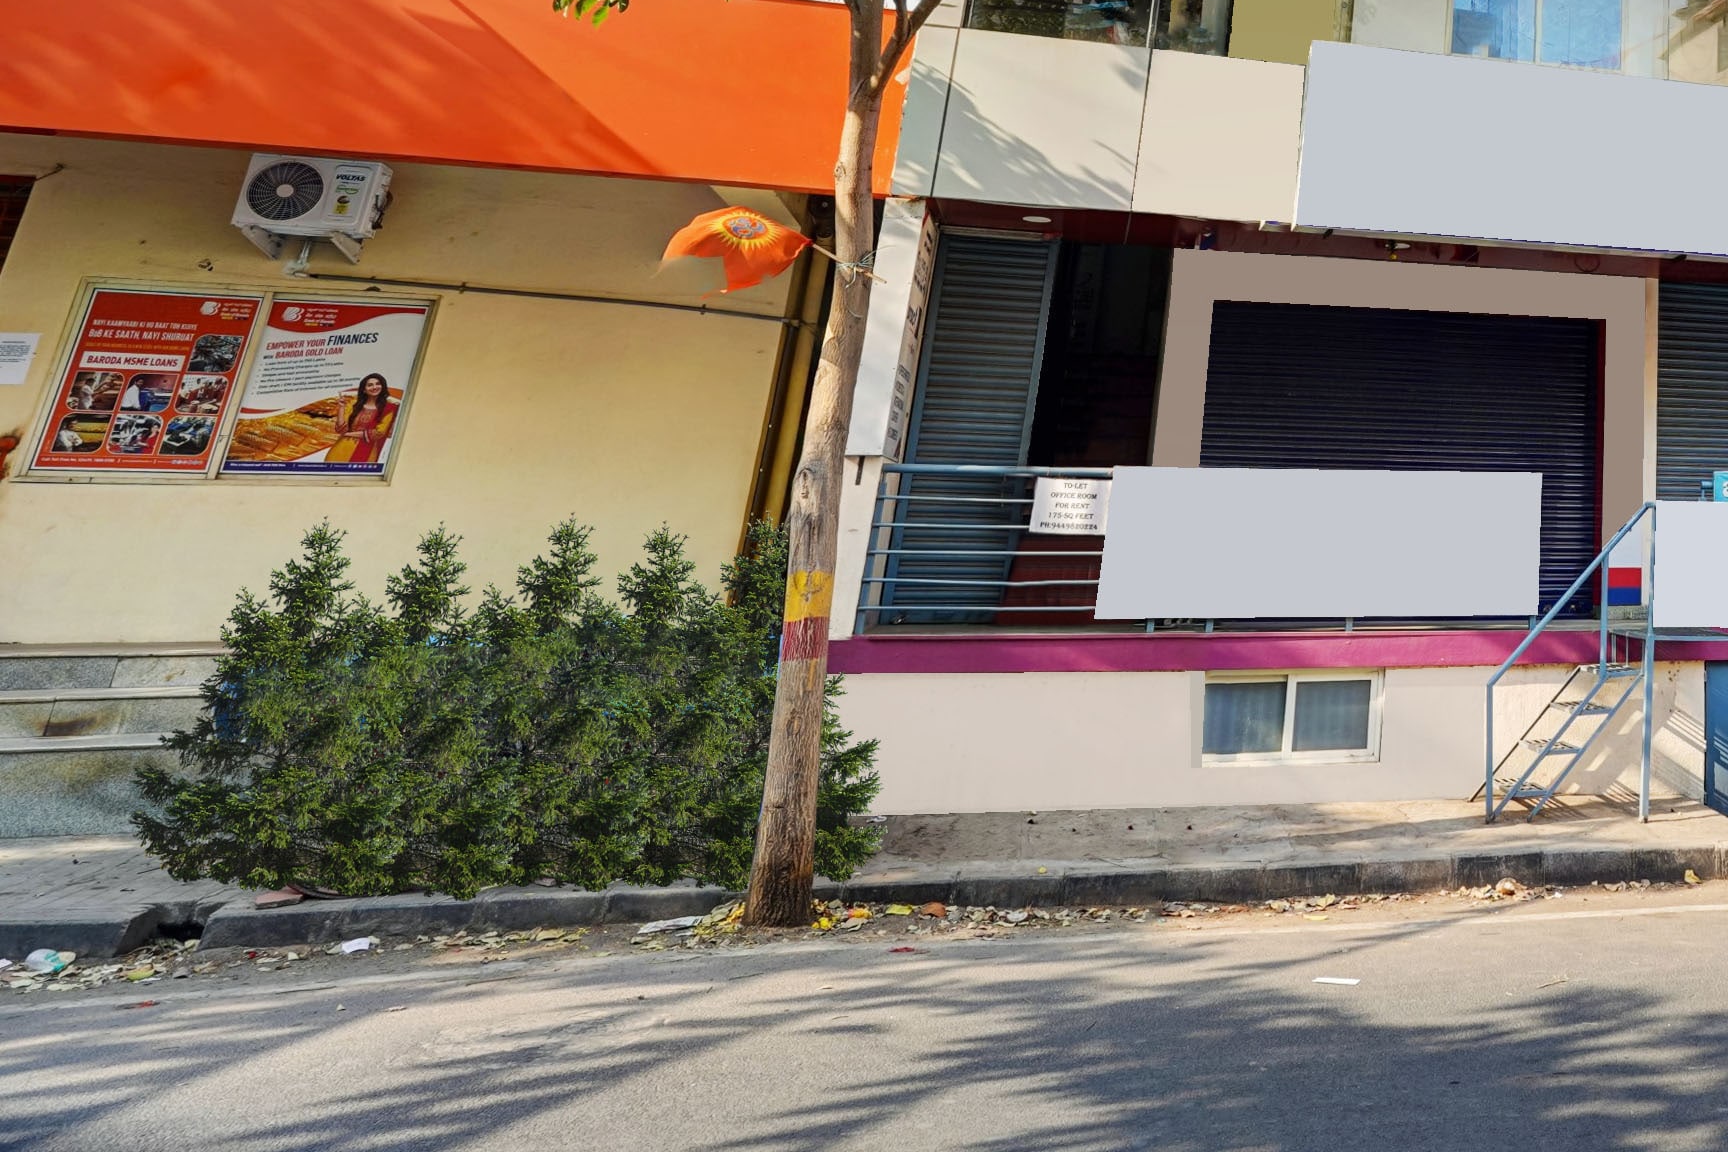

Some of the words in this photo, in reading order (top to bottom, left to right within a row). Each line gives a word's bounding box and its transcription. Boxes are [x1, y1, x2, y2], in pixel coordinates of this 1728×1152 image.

[336, 174, 366, 182] VOLTAS
[103, 329, 114, 338] KE
[142, 332, 160, 340] NAYI
[266, 340, 305, 350] EMPOWER
[306, 338, 326, 348] YOUR
[326, 332, 379, 346] FINANCES
[274, 348, 304, 359] BARODA
[305, 347, 324, 357] GOLD
[324, 347, 344, 356] LOAN
[86, 355, 122, 365] BARODA
[122, 357, 150, 366] MSME
[150, 358, 178, 367] LOANS
[1050, 491, 1076, 499] OFFICE
[1055, 501, 1070, 509] FOR
